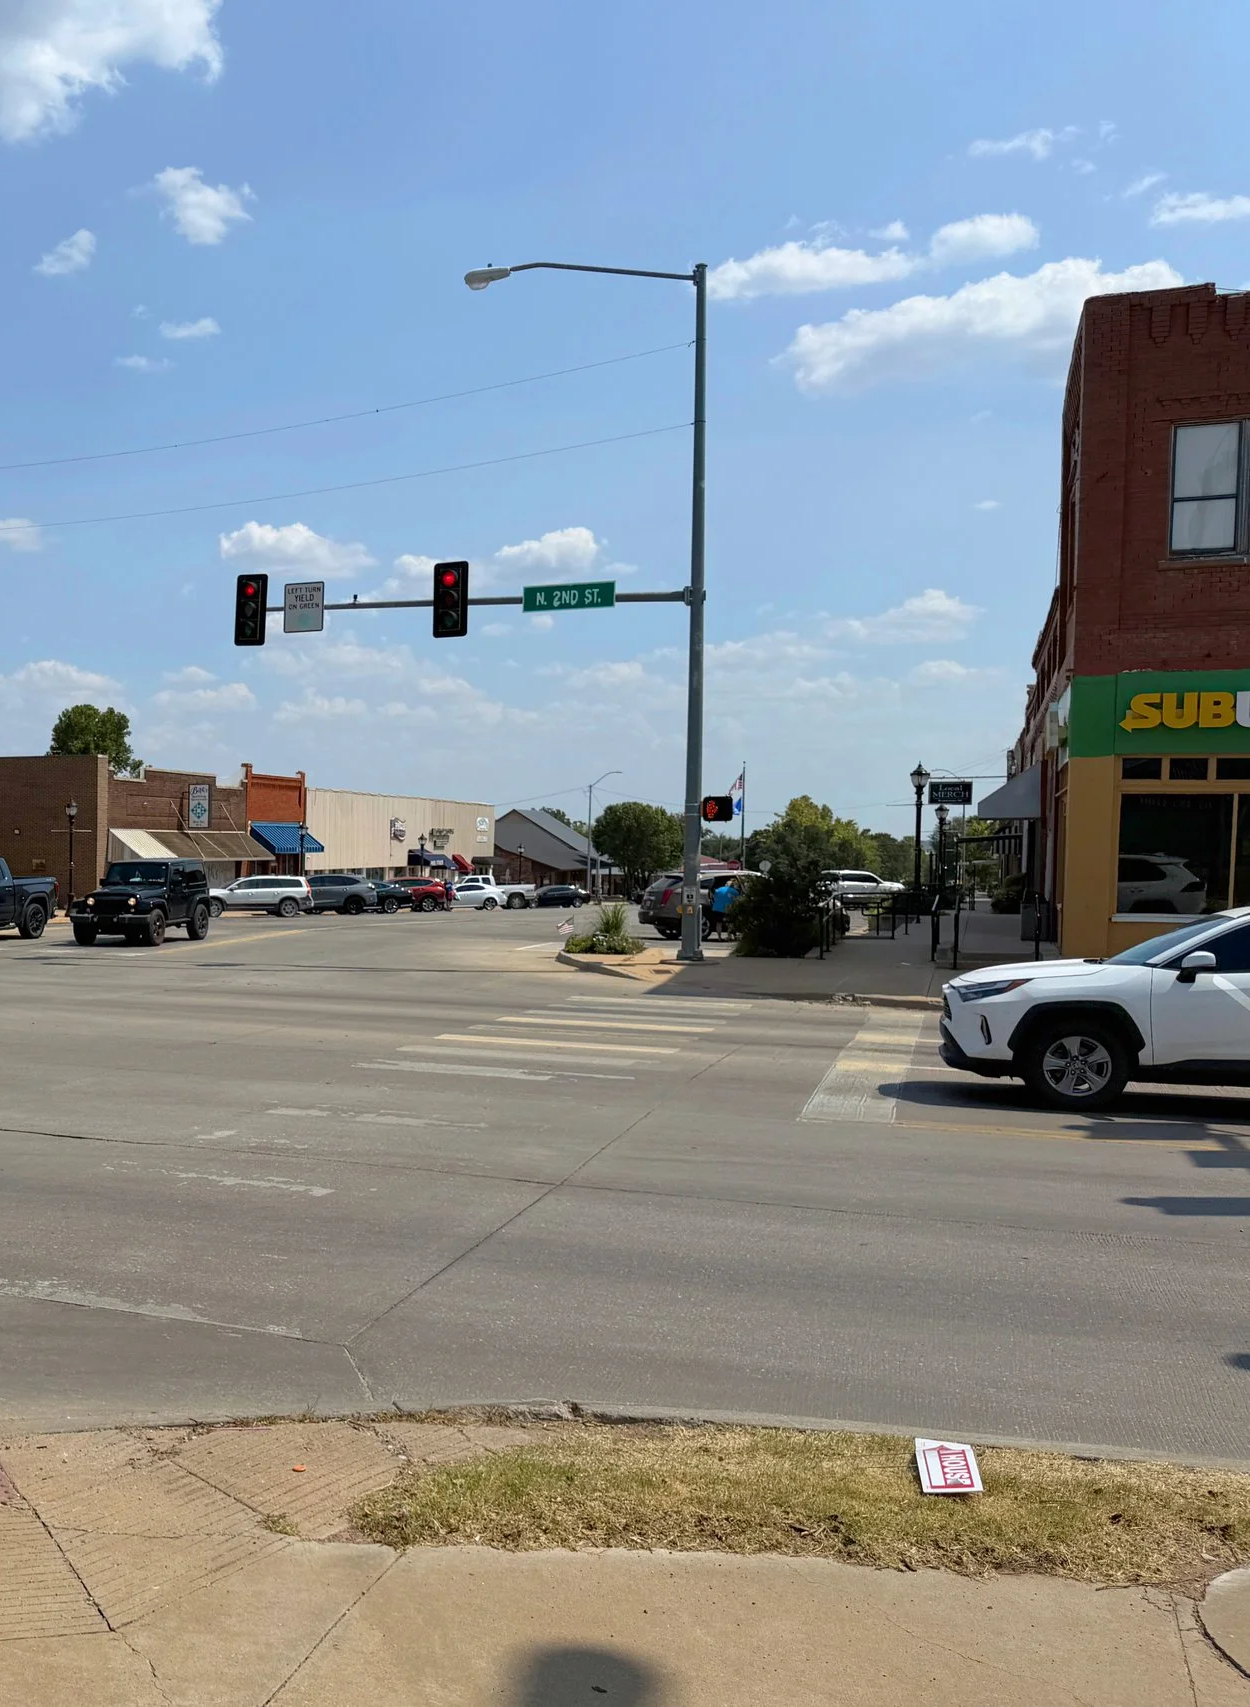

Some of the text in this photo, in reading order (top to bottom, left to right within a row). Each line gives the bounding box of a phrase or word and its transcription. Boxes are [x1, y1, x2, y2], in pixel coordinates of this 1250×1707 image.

[287, 587, 303, 595] LEFT
[294, 593, 315, 603] YIELD
[536, 588, 601, 607] N. 2ND ST.
[299, 602, 320, 610] GREEN
[932, 791, 970, 799] MERCH
